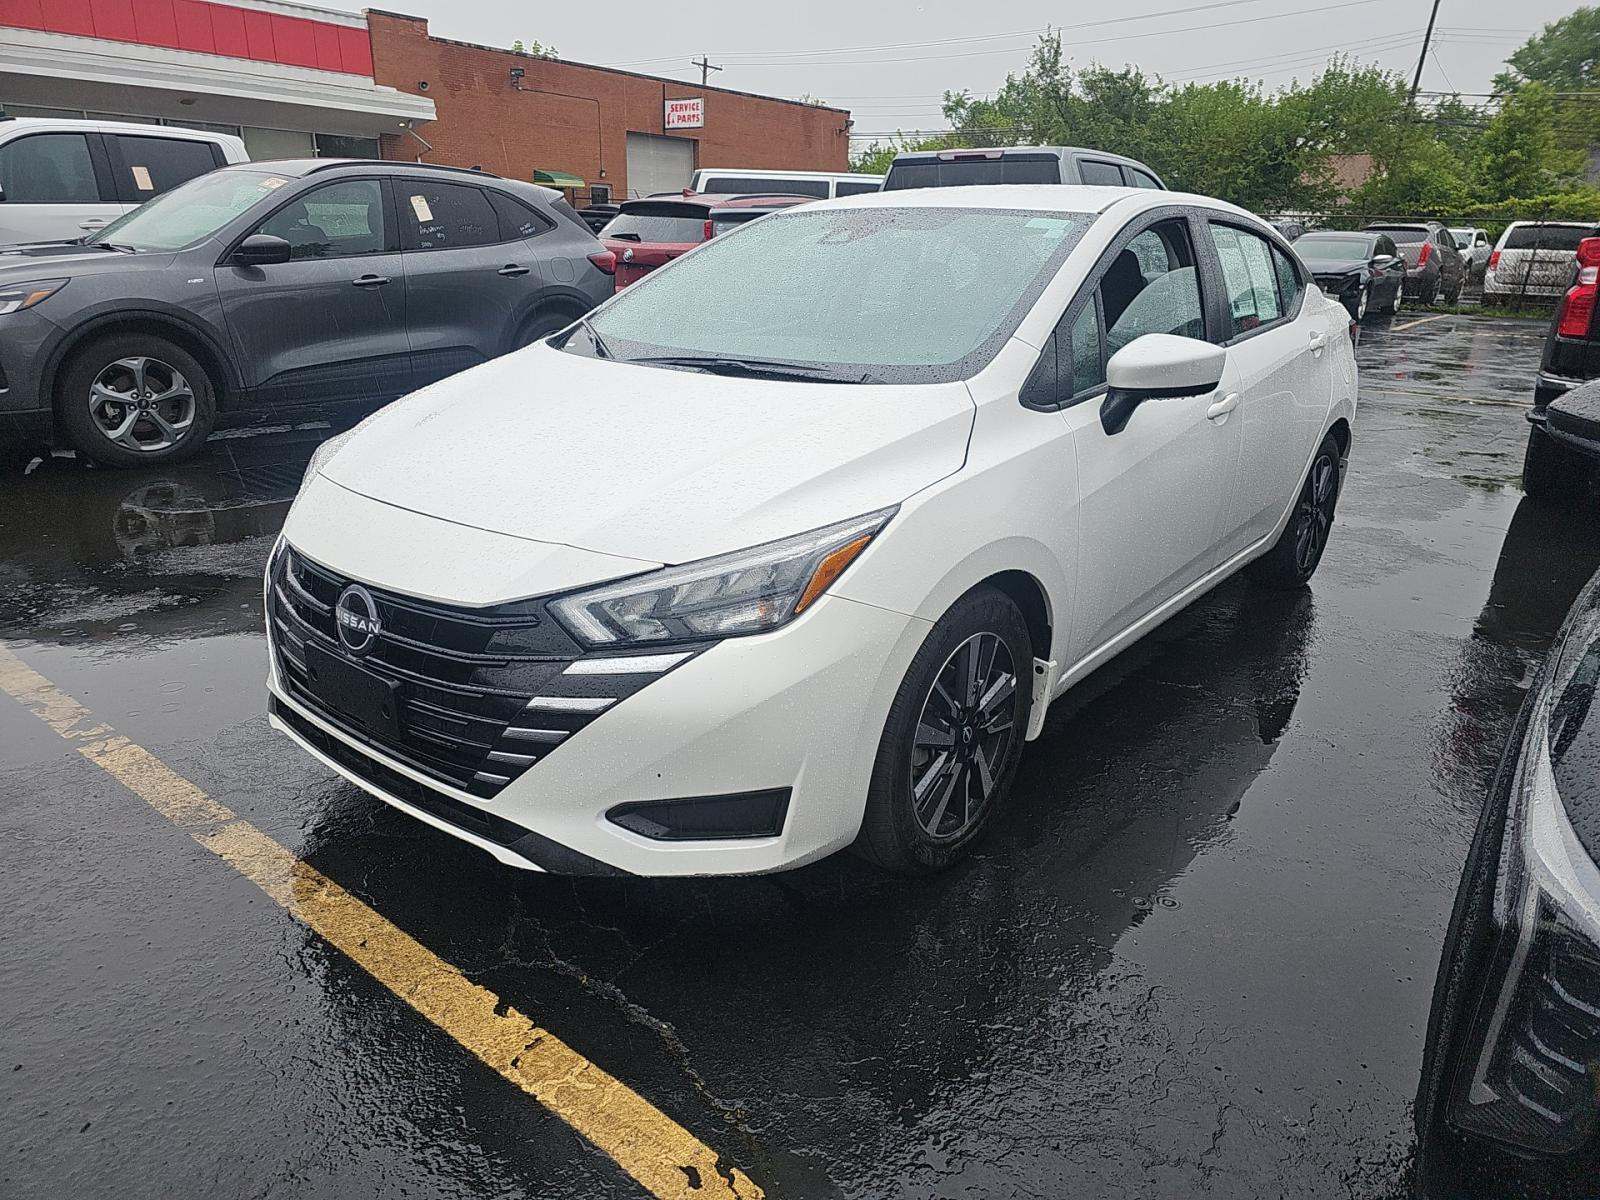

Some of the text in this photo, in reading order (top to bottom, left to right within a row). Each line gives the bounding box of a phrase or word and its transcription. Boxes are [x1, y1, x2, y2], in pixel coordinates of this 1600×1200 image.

[671, 103, 700, 112] SERVICE
[677, 114, 700, 123] PARTS
[336, 607, 379, 633] NISSAN
